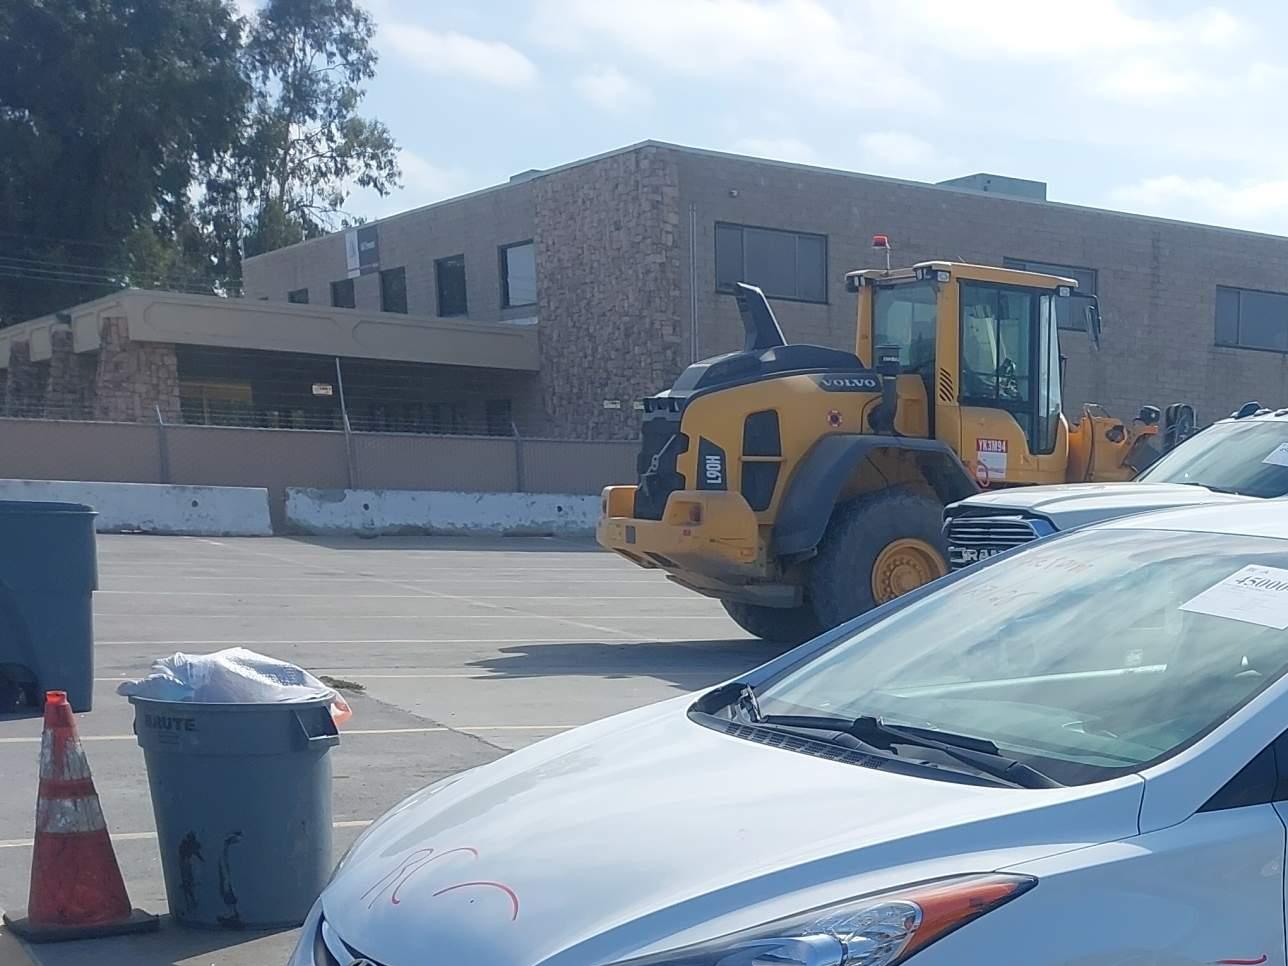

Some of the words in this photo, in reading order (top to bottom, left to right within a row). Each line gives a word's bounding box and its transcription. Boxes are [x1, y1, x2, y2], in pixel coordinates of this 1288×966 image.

[822, 379, 876, 388] VOLVO
[705, 455, 722, 484] L90H
[144, 714, 196, 731] BRUTE
